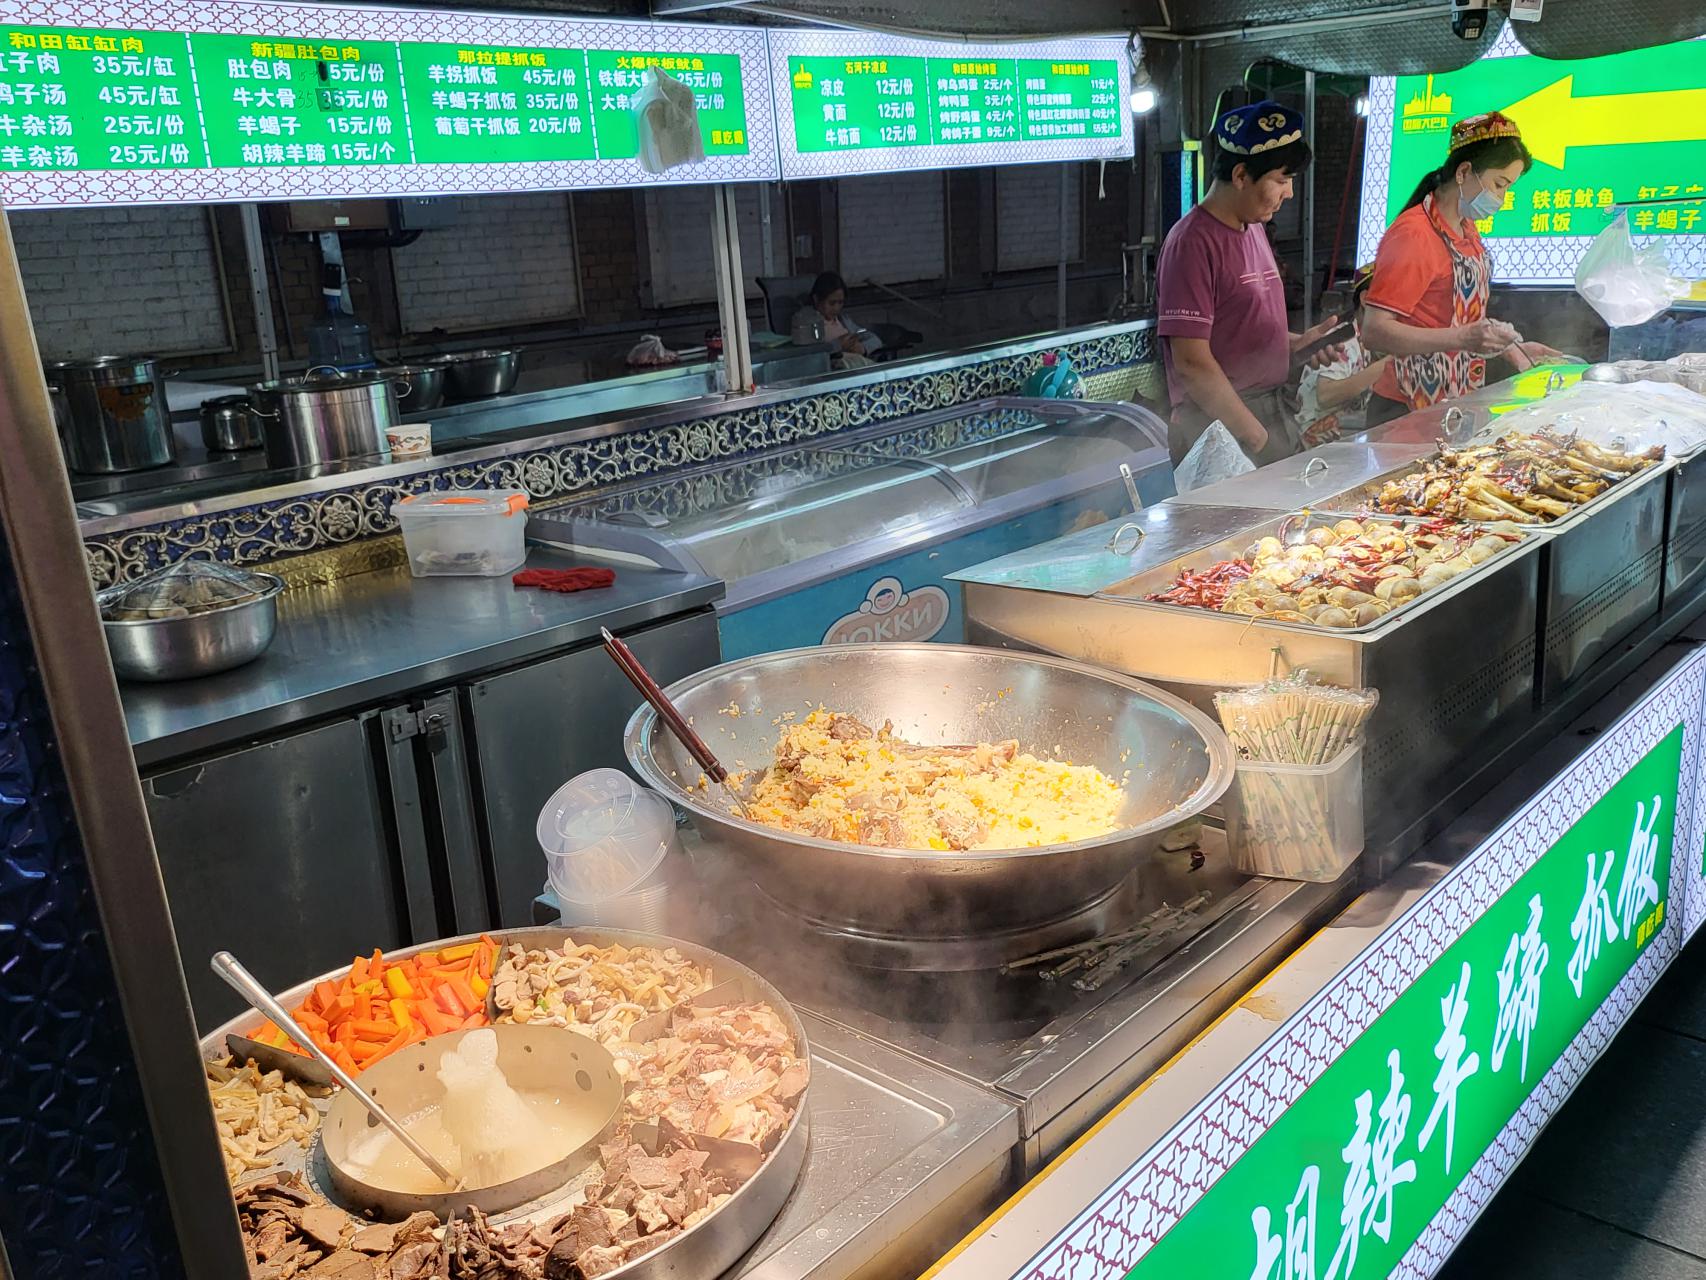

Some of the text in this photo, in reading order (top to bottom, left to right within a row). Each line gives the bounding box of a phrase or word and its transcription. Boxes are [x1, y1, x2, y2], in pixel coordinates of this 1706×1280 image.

[9, 32, 144, 53] 和田缸缸肉
[250, 42, 361, 61] 新疆肚包肉
[92, 55, 176, 76] 35元/缸
[458, 50, 546, 66] 那拉提抓饭
[845, 61, 888, 74] 石河子凉皮
[228, 59, 292, 80] 肚包肉
[428, 65, 576, 86] 羊拐抓饭 45元/份
[820, 78, 845, 96] 凉皮
[876, 78, 913, 95] 12元/份
[984, 78, 1013, 90] 2元/个
[98, 85, 181, 106] 45元/缸
[233, 87, 296, 108] 牛大骨
[432, 91, 578, 110] 羊蝎子抓饭 35元/份
[985, 94, 1014, 106] 3元/个
[823, 101, 915, 122] 黄面 12元/份
[986, 109, 1014, 122] 4元/个
[103, 114, 184, 135] 25元/份
[238, 116, 392, 136] 羊蝎子 15元/份
[435, 117, 581, 135] 葡萄干抓饭 20元/份
[825, 124, 917, 146] 牛筋面 12元/份
[1, 143, 190, 167] 羊杂汤 25元/份
[242, 141, 395, 163] 胡辣羊蹄 15元/个
[1532, 187, 1614, 209] 铁板鱿鱼
[1531, 212, 1571, 233] 抓饭
[1634, 209, 1702, 231] 羊蝎子
